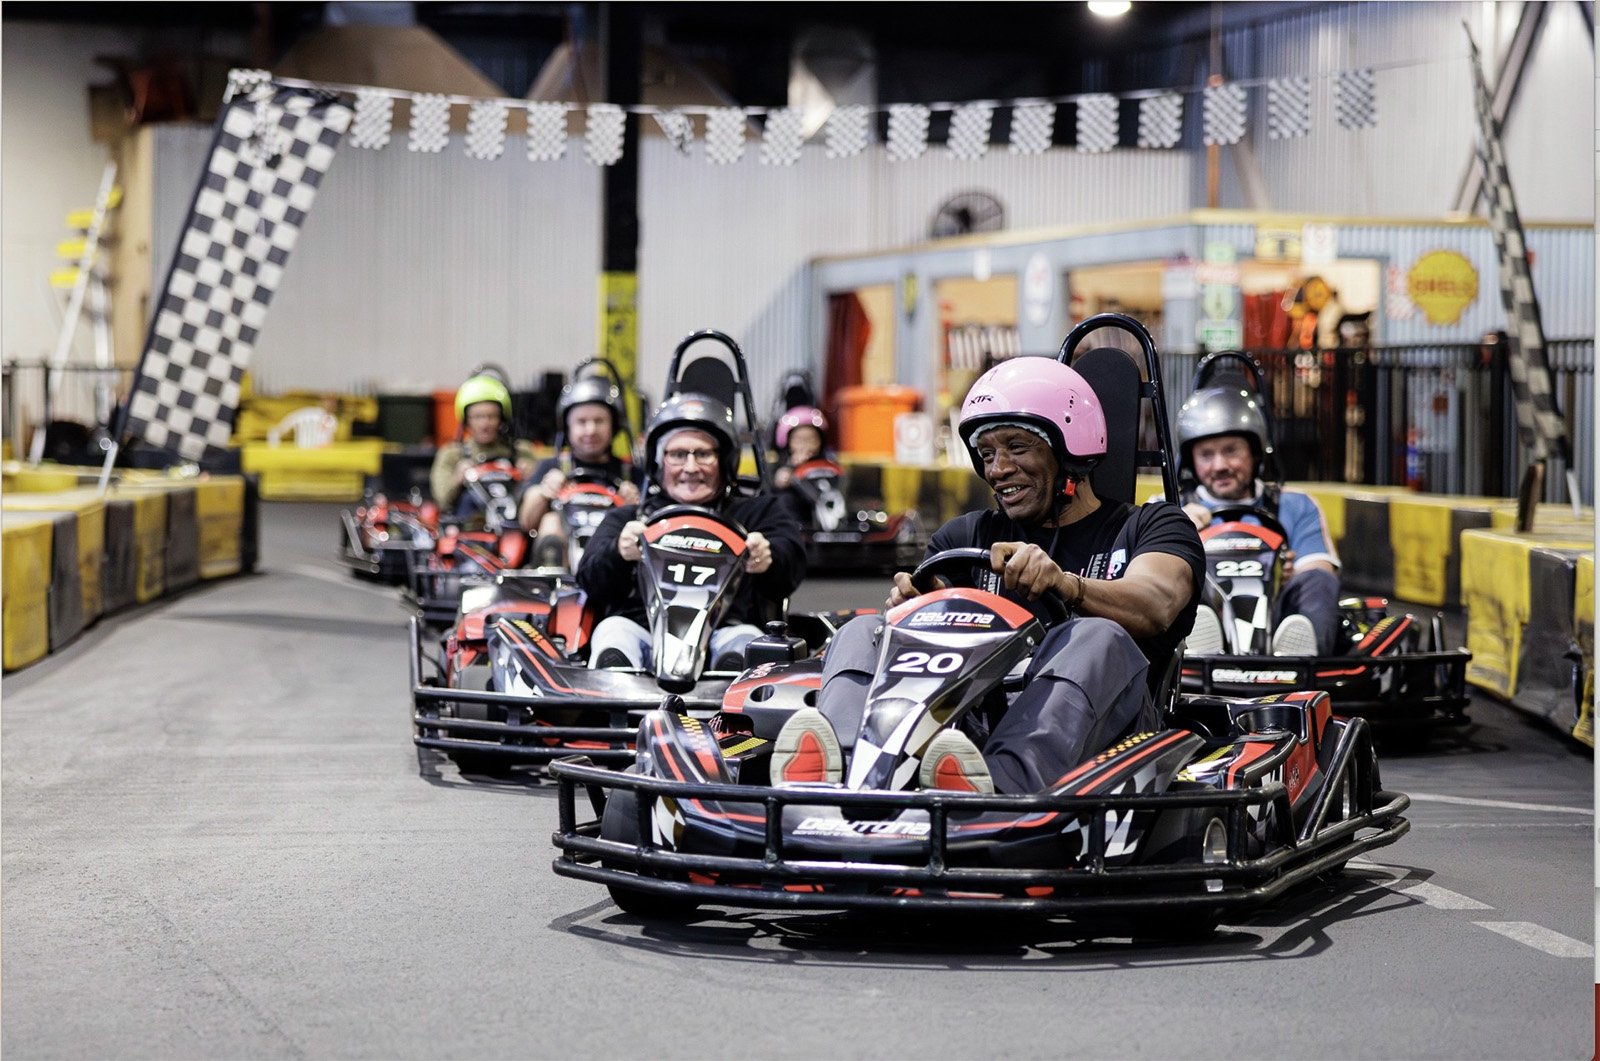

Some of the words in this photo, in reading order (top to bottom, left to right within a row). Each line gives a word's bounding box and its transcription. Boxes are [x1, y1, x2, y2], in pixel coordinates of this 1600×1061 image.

[667, 563, 717, 586] 17
[1215, 560, 1264, 577] 22
[889, 651, 964, 674] 20
